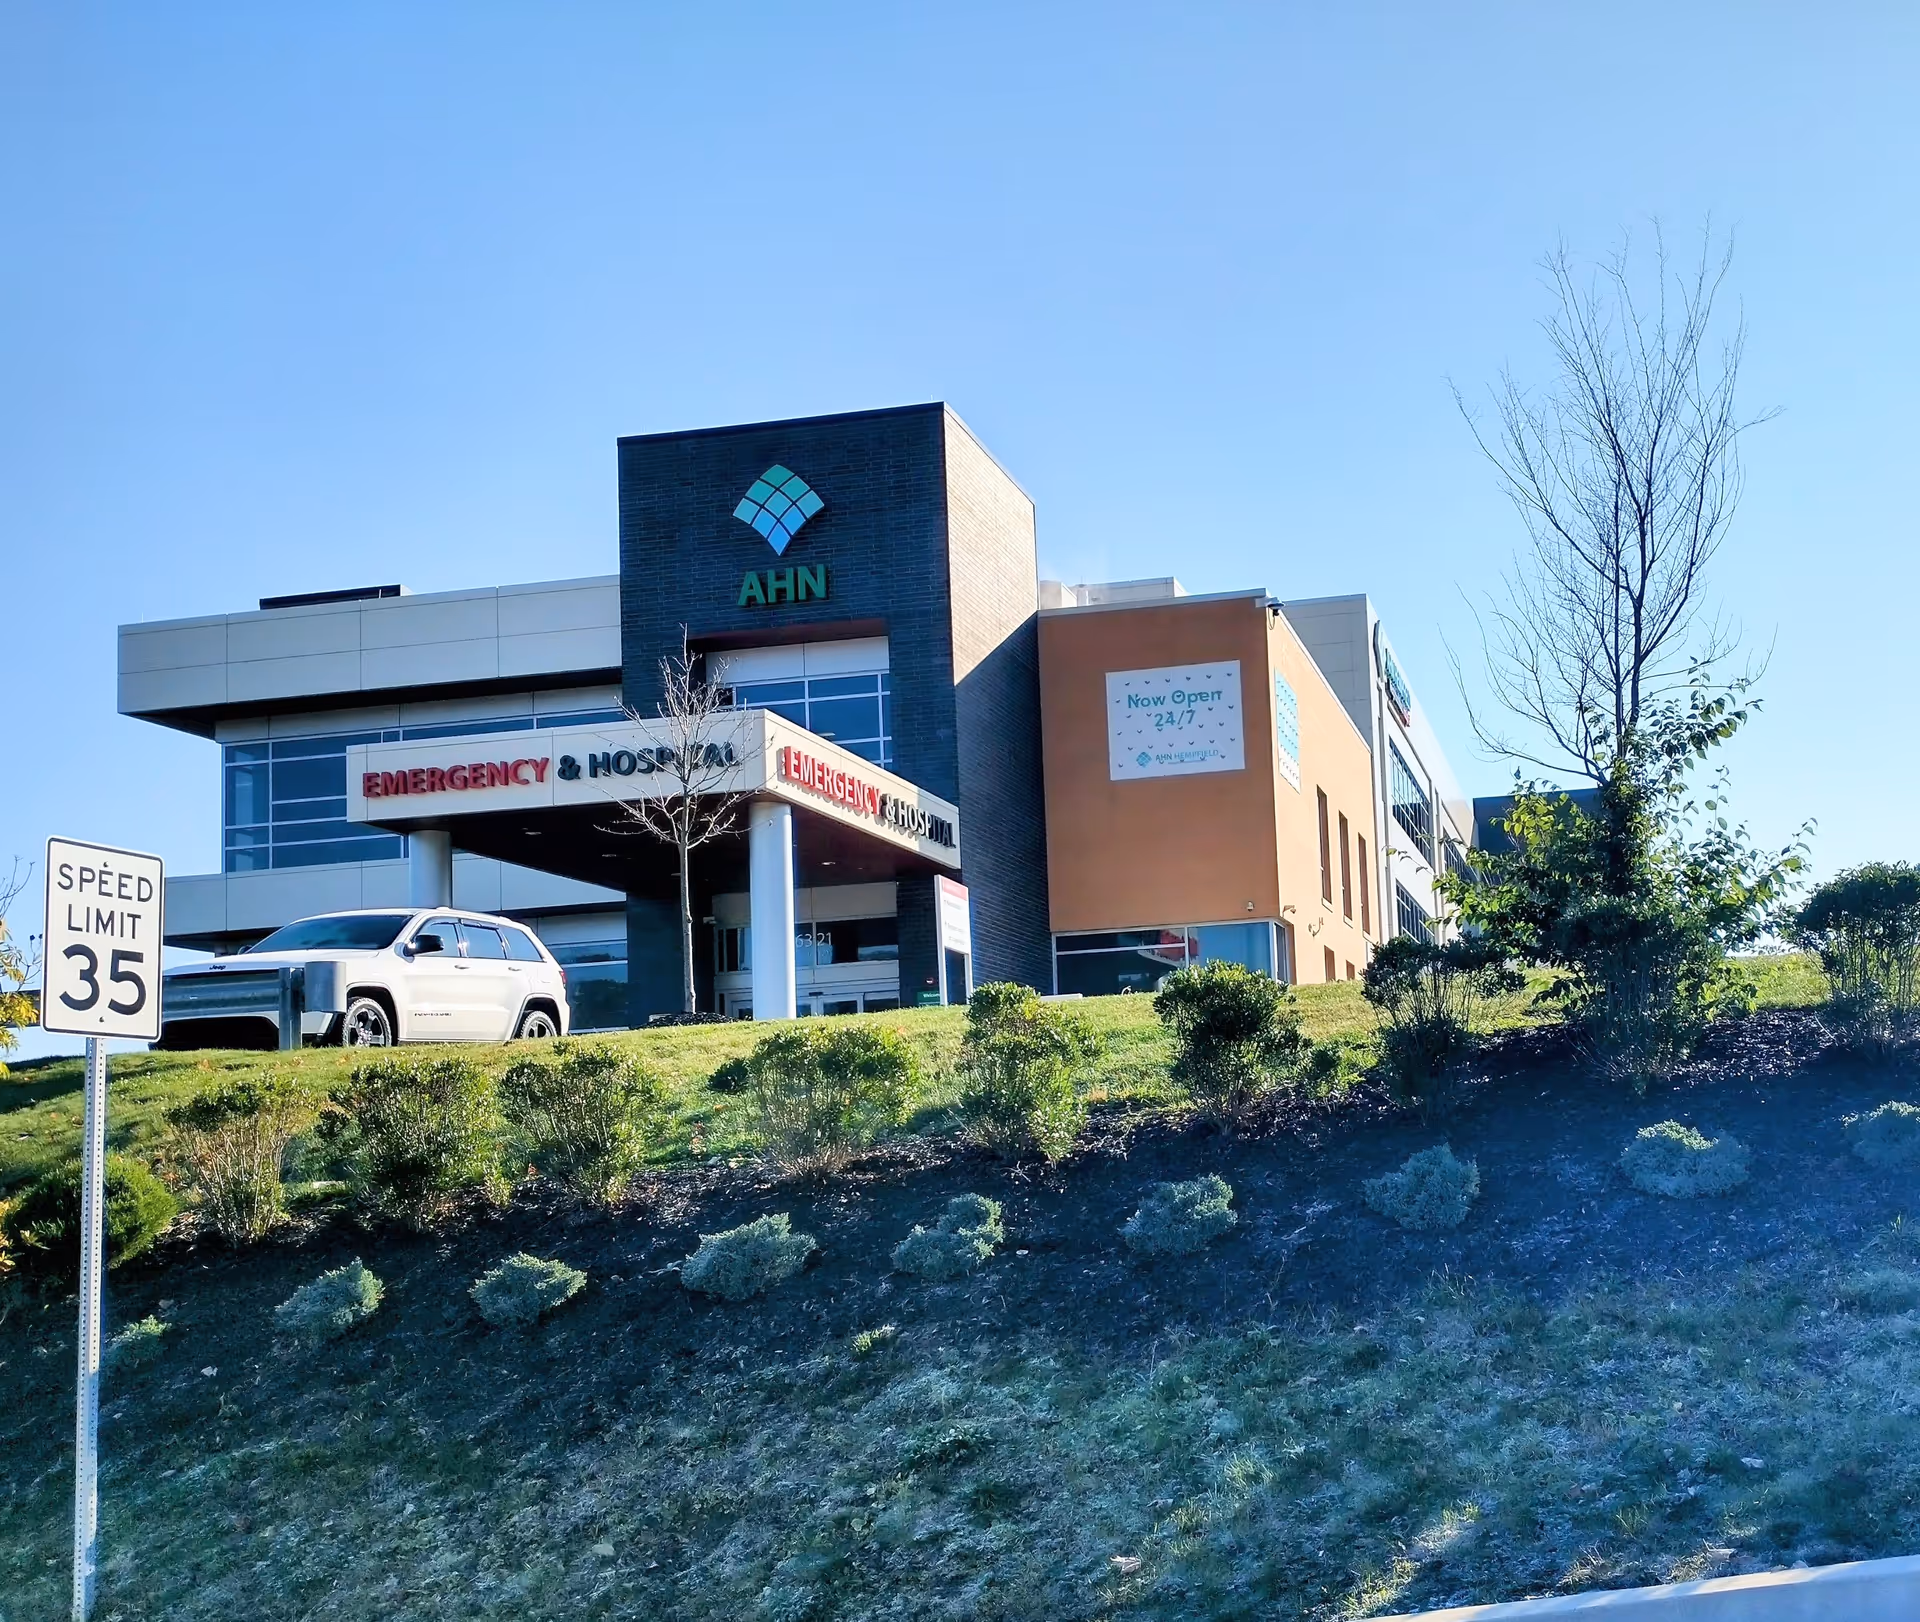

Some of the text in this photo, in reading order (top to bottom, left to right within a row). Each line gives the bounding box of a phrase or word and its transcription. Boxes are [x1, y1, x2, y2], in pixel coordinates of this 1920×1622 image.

[737, 564, 828, 606] AHN
[1127, 689, 1223, 708] Now Open
[1154, 709, 1196, 727] 24/7
[363, 757, 550, 797] EMERGENCY
[557, 754, 581, 781] &
[782, 746, 957, 849] EMERGENCY & HOSPITAL
[57, 863, 153, 902] SPEED
[67, 903, 141, 939] LIMIT
[795, 932, 832, 948] 6321
[59, 943, 146, 1016] 35
